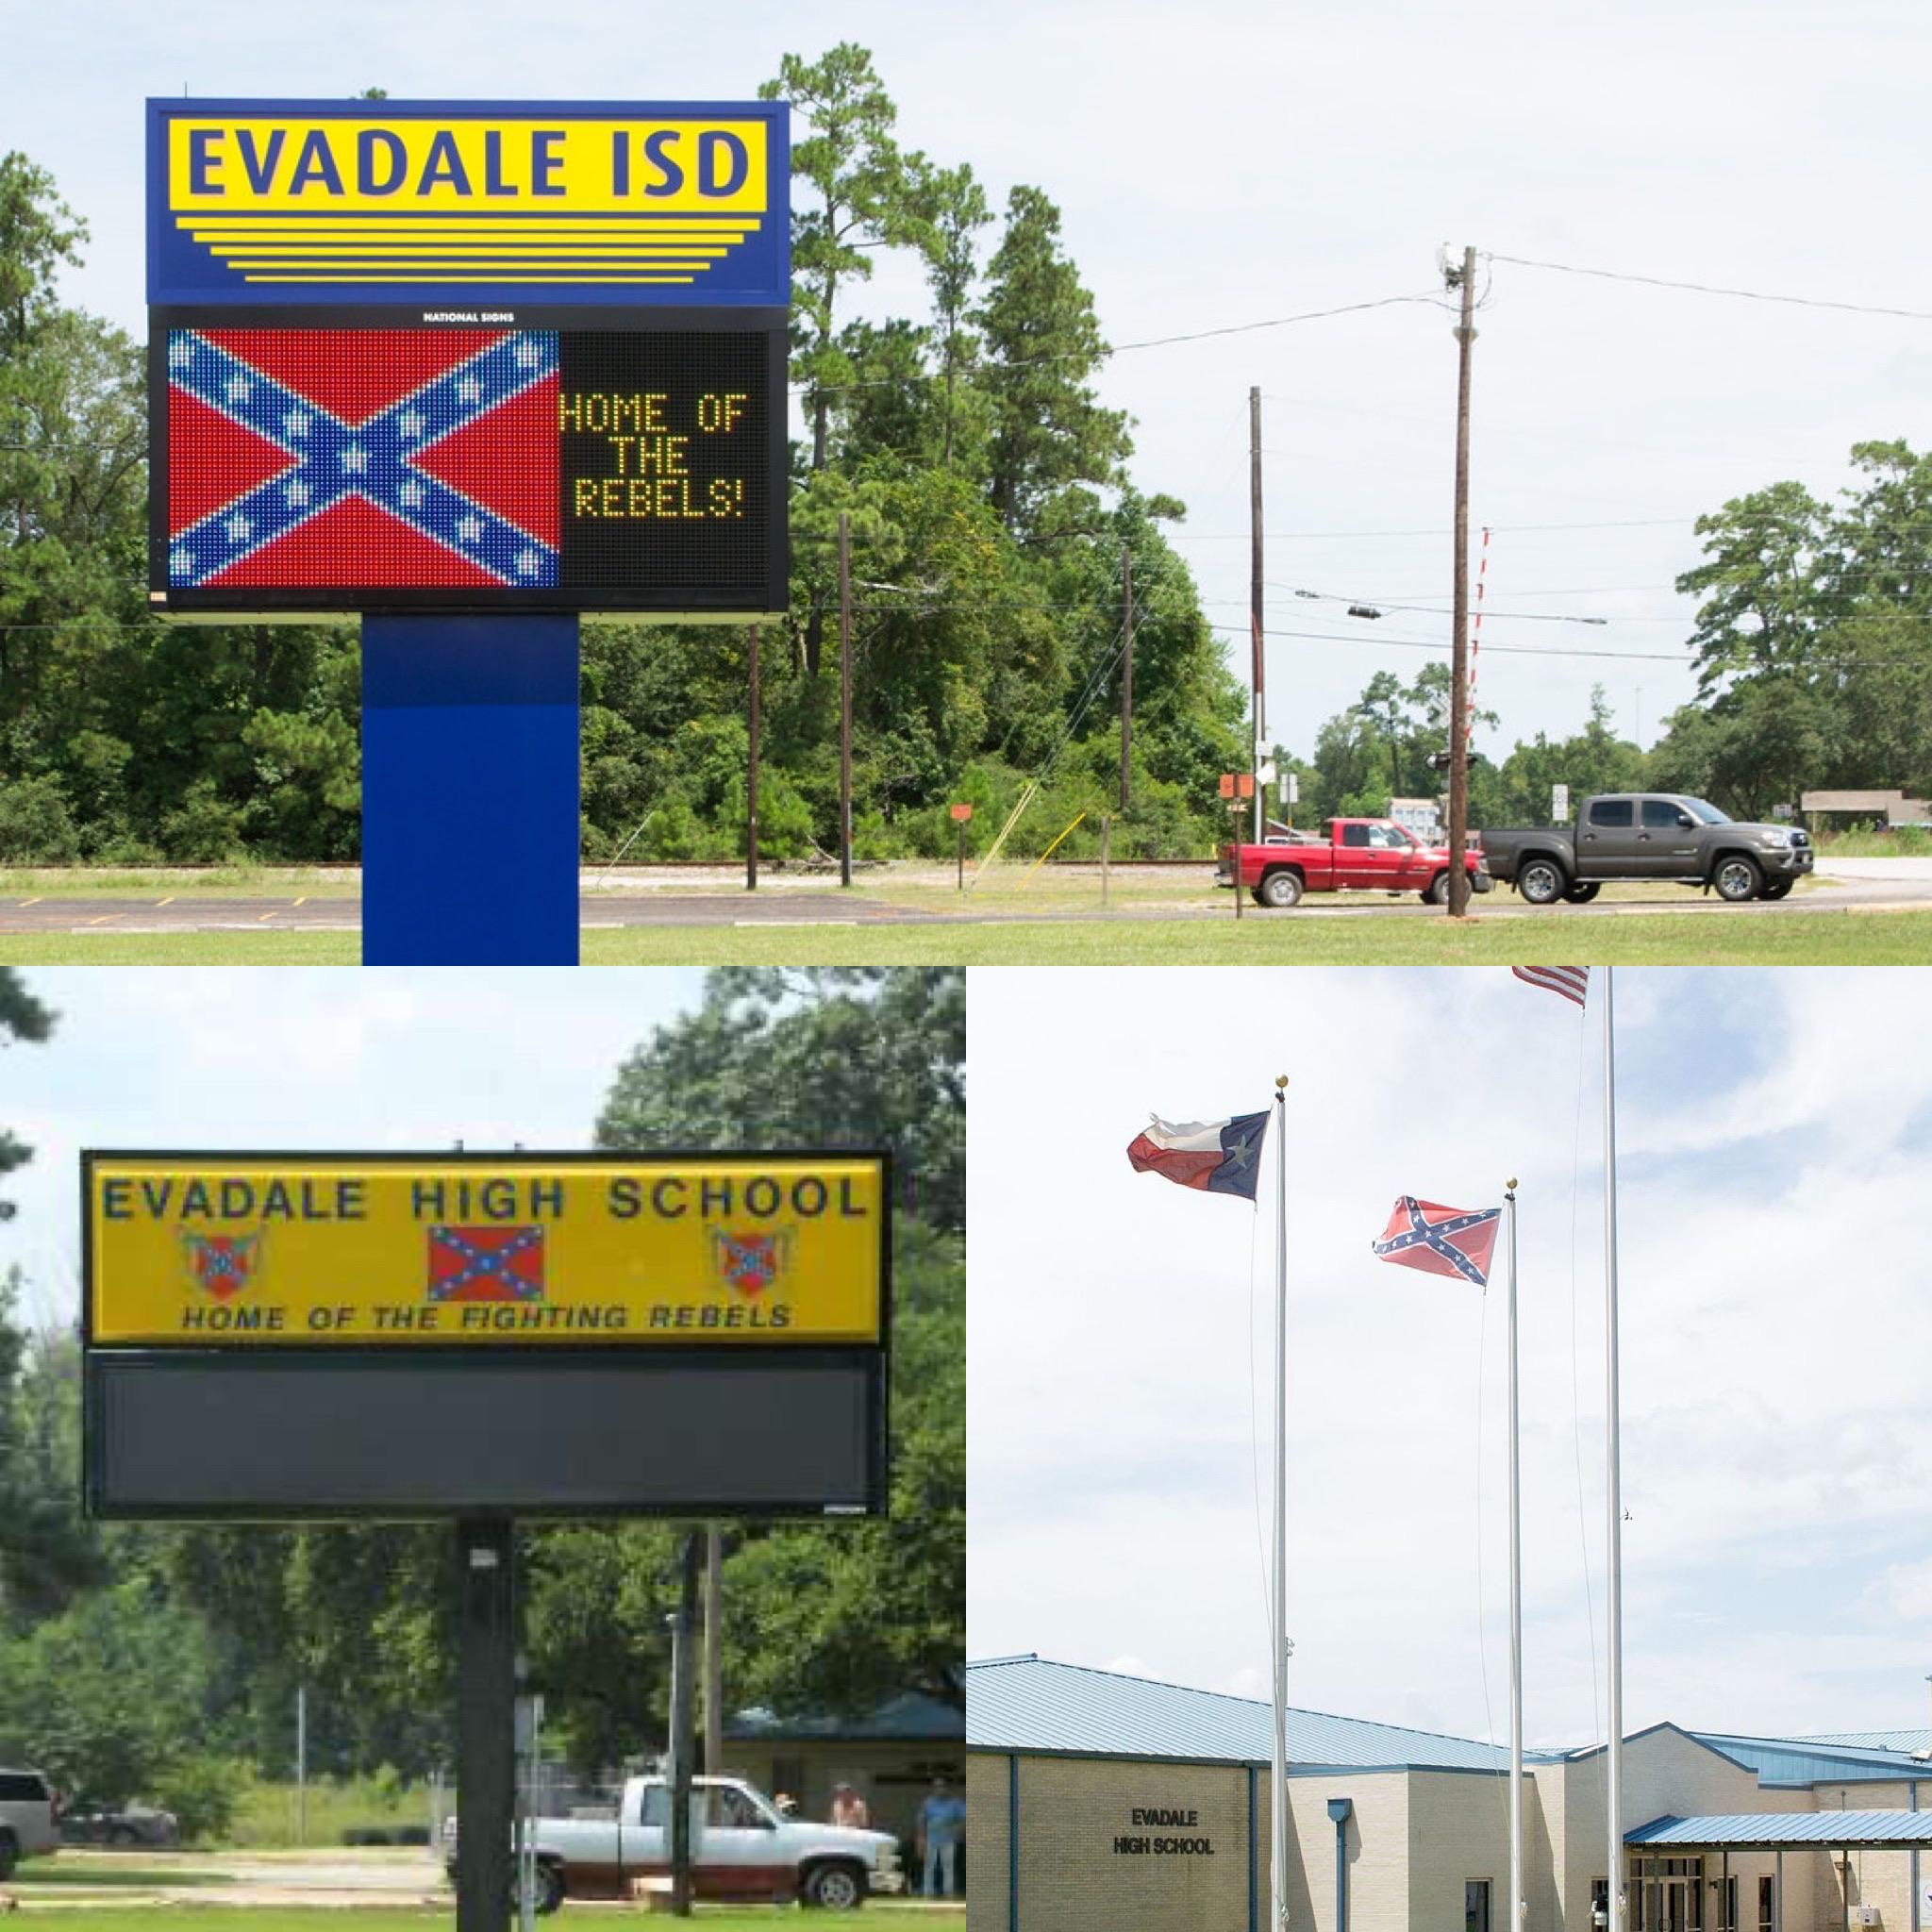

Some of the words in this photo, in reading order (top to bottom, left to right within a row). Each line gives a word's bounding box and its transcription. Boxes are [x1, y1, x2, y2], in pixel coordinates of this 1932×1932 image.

[189, 129, 567, 197] EVADALE
[612, 129, 751, 198] ISD
[423, 312, 478, 322] NATIONAL
[481, 312, 514, 322] SIGNS
[558, 393, 667, 433] HOME
[698, 393, 747, 433] OF
[608, 436, 689, 475] THE
[574, 478, 744, 517] REBELS!
[103, 1178, 366, 1221] EVADALE
[411, 1178, 563, 1220] HIGH
[608, 1176, 867, 1218] SCHOOL
[182, 1306, 287, 1331] HOME
[308, 1306, 357, 1331] OF
[373, 1306, 439, 1330] THE
[461, 1305, 628, 1331] FIGHTING
[649, 1305, 791, 1329] REBELS
[1132, 1808, 1198, 1826] EVADALE
[1114, 1837, 1150, 1855] HIGH
[1154, 1837, 1215, 1855] SCHOOL
